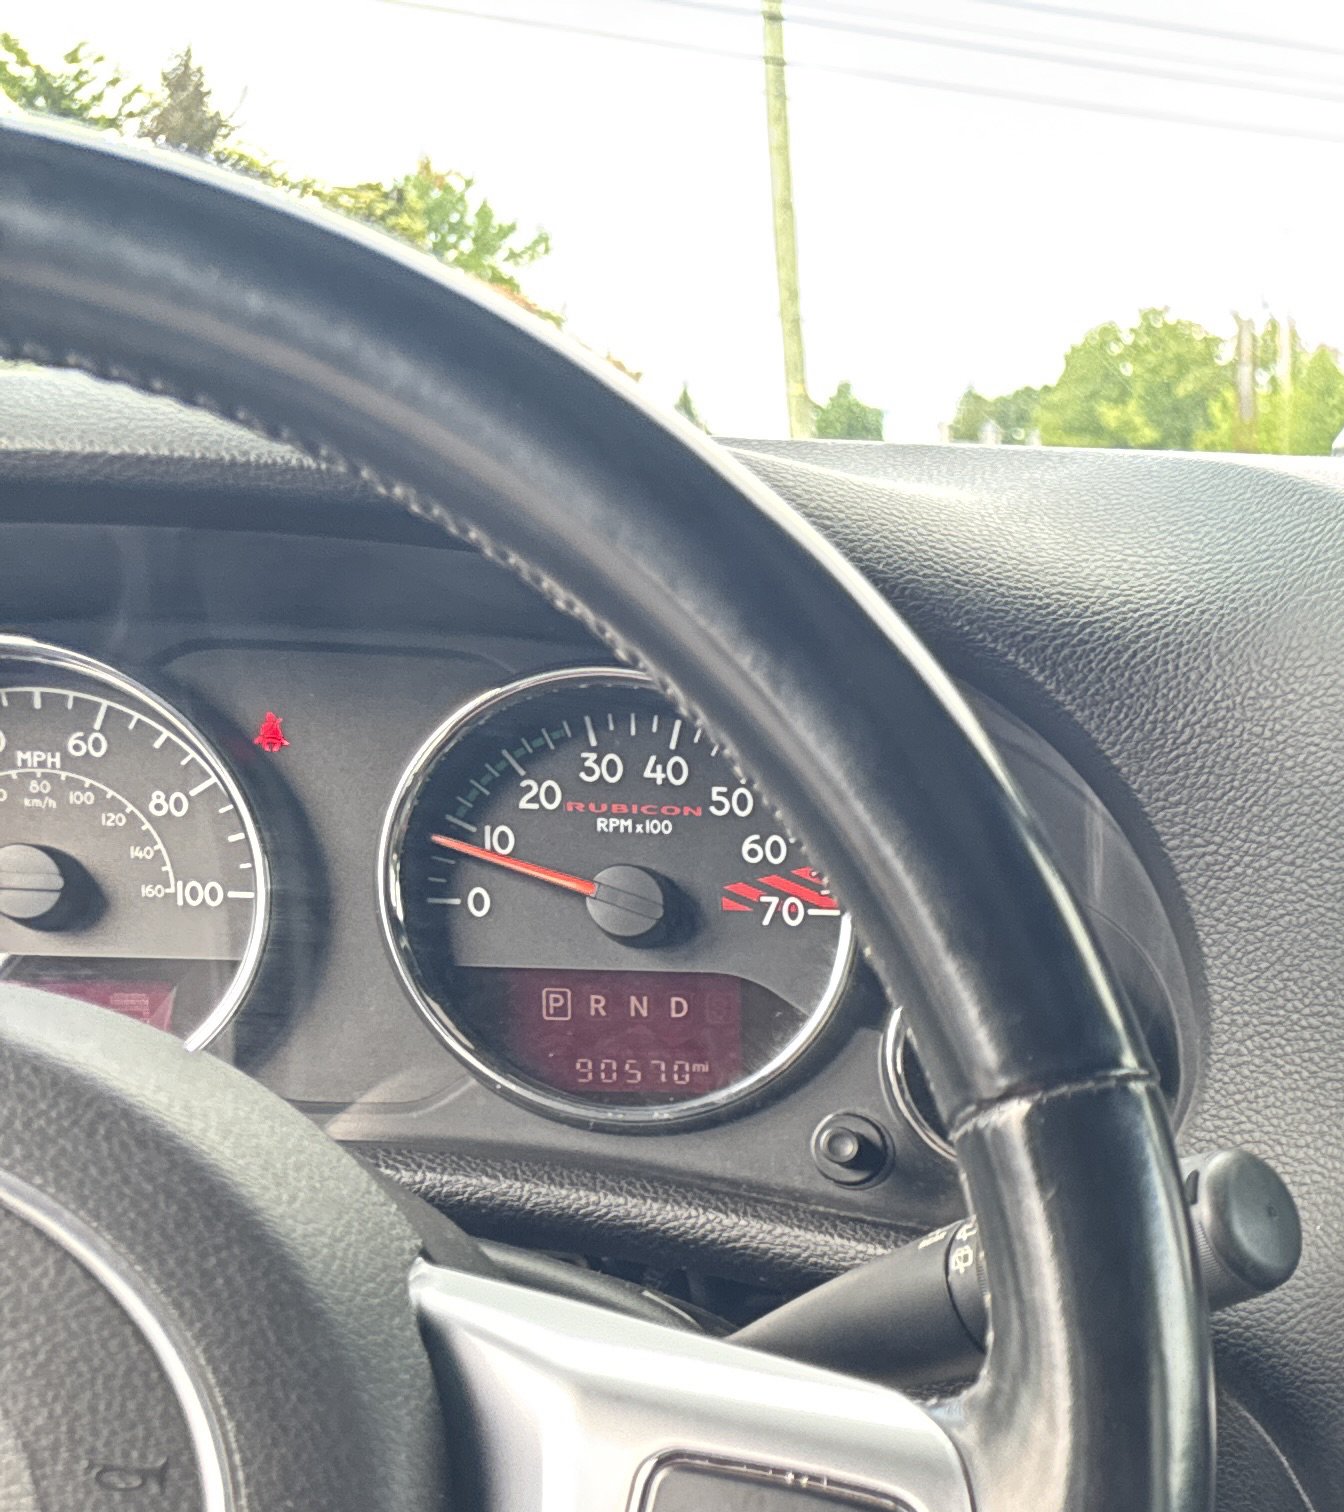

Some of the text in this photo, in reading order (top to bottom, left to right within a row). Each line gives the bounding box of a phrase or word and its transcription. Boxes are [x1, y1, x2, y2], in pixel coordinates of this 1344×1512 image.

[67, 732, 108, 757] 60
[17, 751, 61, 769] MPH
[579, 754, 625, 786] 30
[643, 755, 689, 787] 40
[29, 780, 51, 794] 80
[69, 791, 95, 806] 100
[518, 780, 563, 812] 20
[24, 795, 57, 809] km/h
[149, 790, 189, 818] 80
[567, 800, 702, 818] RUBICON
[709, 787, 754, 818] 50
[101, 813, 127, 827] 120
[596, 818, 632, 836] RPM
[130, 845, 154, 860] 140
[484, 825, 516, 856] 10
[742, 835, 788, 866] 60
[141, 884, 165, 897] 160
[176, 881, 224, 907] 100
[467, 887, 491, 918] 0
[760, 897, 805, 928] 70
[549, 994, 689, 1019] P R N D
